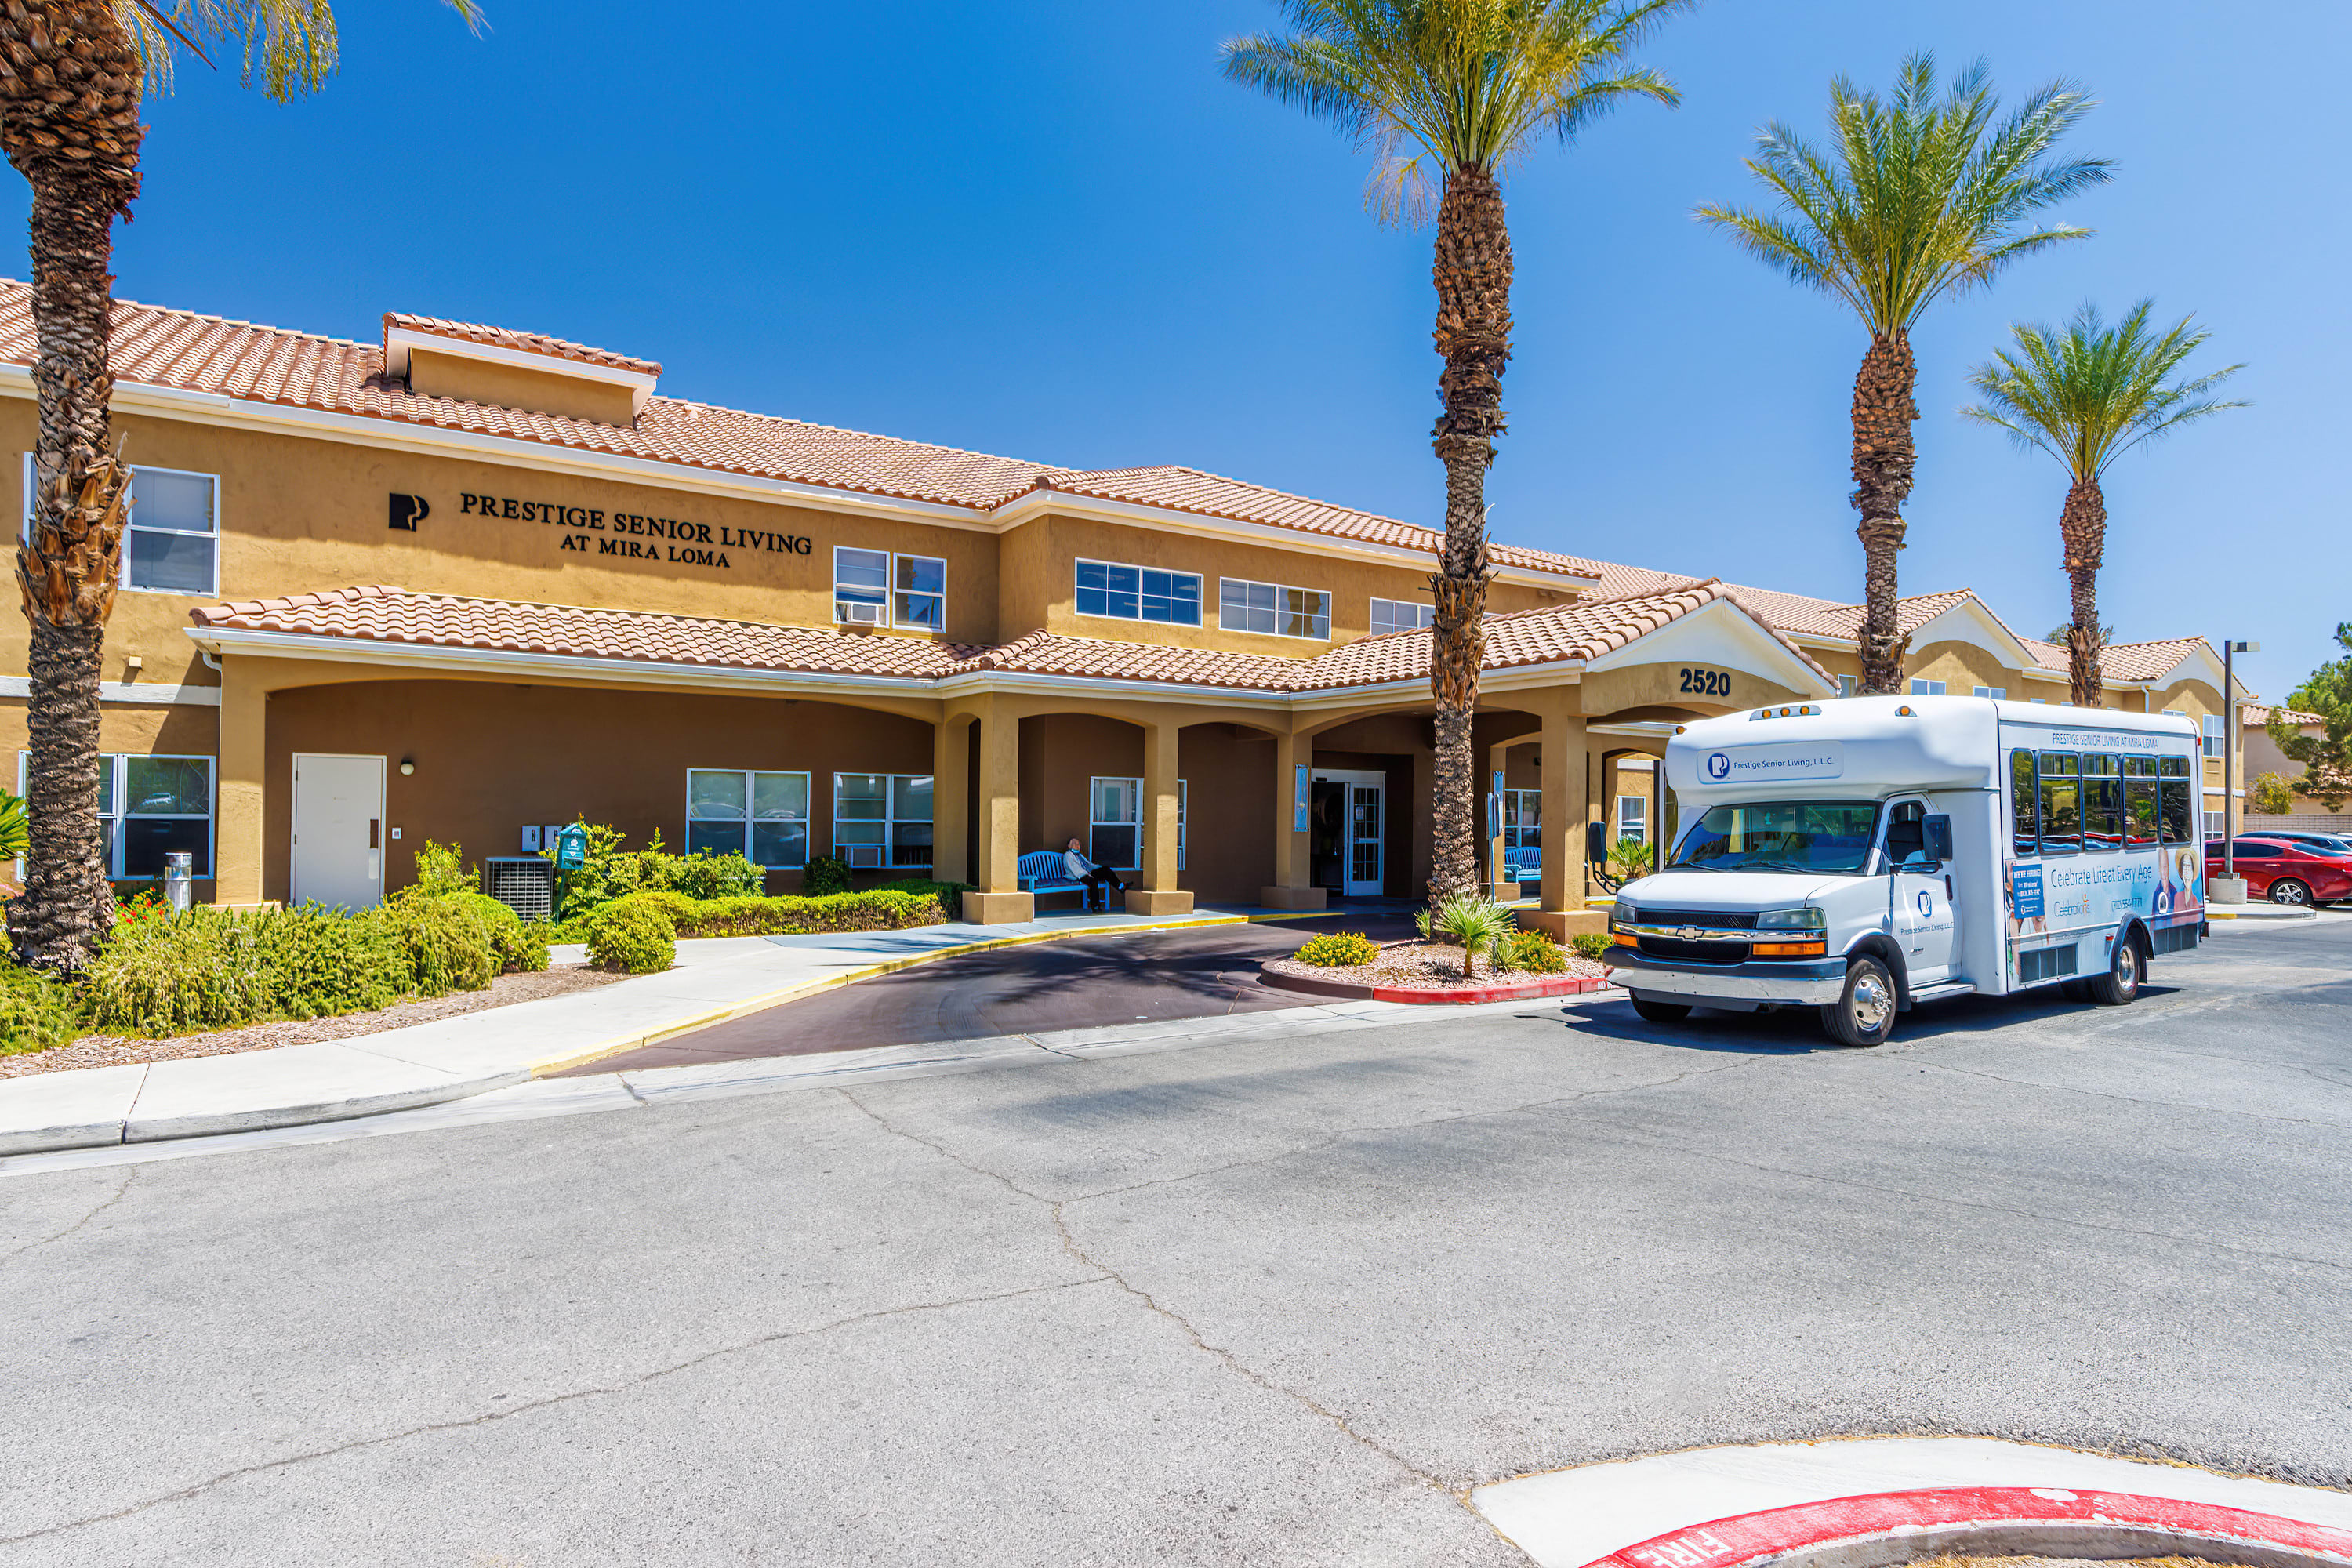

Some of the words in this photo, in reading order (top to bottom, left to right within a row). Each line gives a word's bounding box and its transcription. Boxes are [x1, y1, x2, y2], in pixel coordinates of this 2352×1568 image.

[460, 492, 605, 530] PRESTIGE
[614, 513, 713, 544] SENIOR
[720, 526, 812, 555] LIVING
[560, 533, 590, 552] AT
[599, 538, 660, 561] MIRA
[668, 546, 730, 568] LOMA
[1680, 668, 1731, 697] 2520
[2053, 732, 2079, 746] PRESTIGE
[2081, 734, 2100, 746] SENIOR
[2101, 735, 2120, 747] LIVING
[1733, 761, 1761, 770] Prestige
[1762, 760, 1786, 768] Senior
[1788, 758, 1813, 768] Living,
[2051, 868, 2091, 887] Celebrate
[2092, 865, 2107, 884] Life
[2107, 866, 2116, 883] at
[2117, 865, 2136, 885] Every
[2138, 863, 2152, 884] Age
[1634, 1530, 1733, 1568] FIRE
